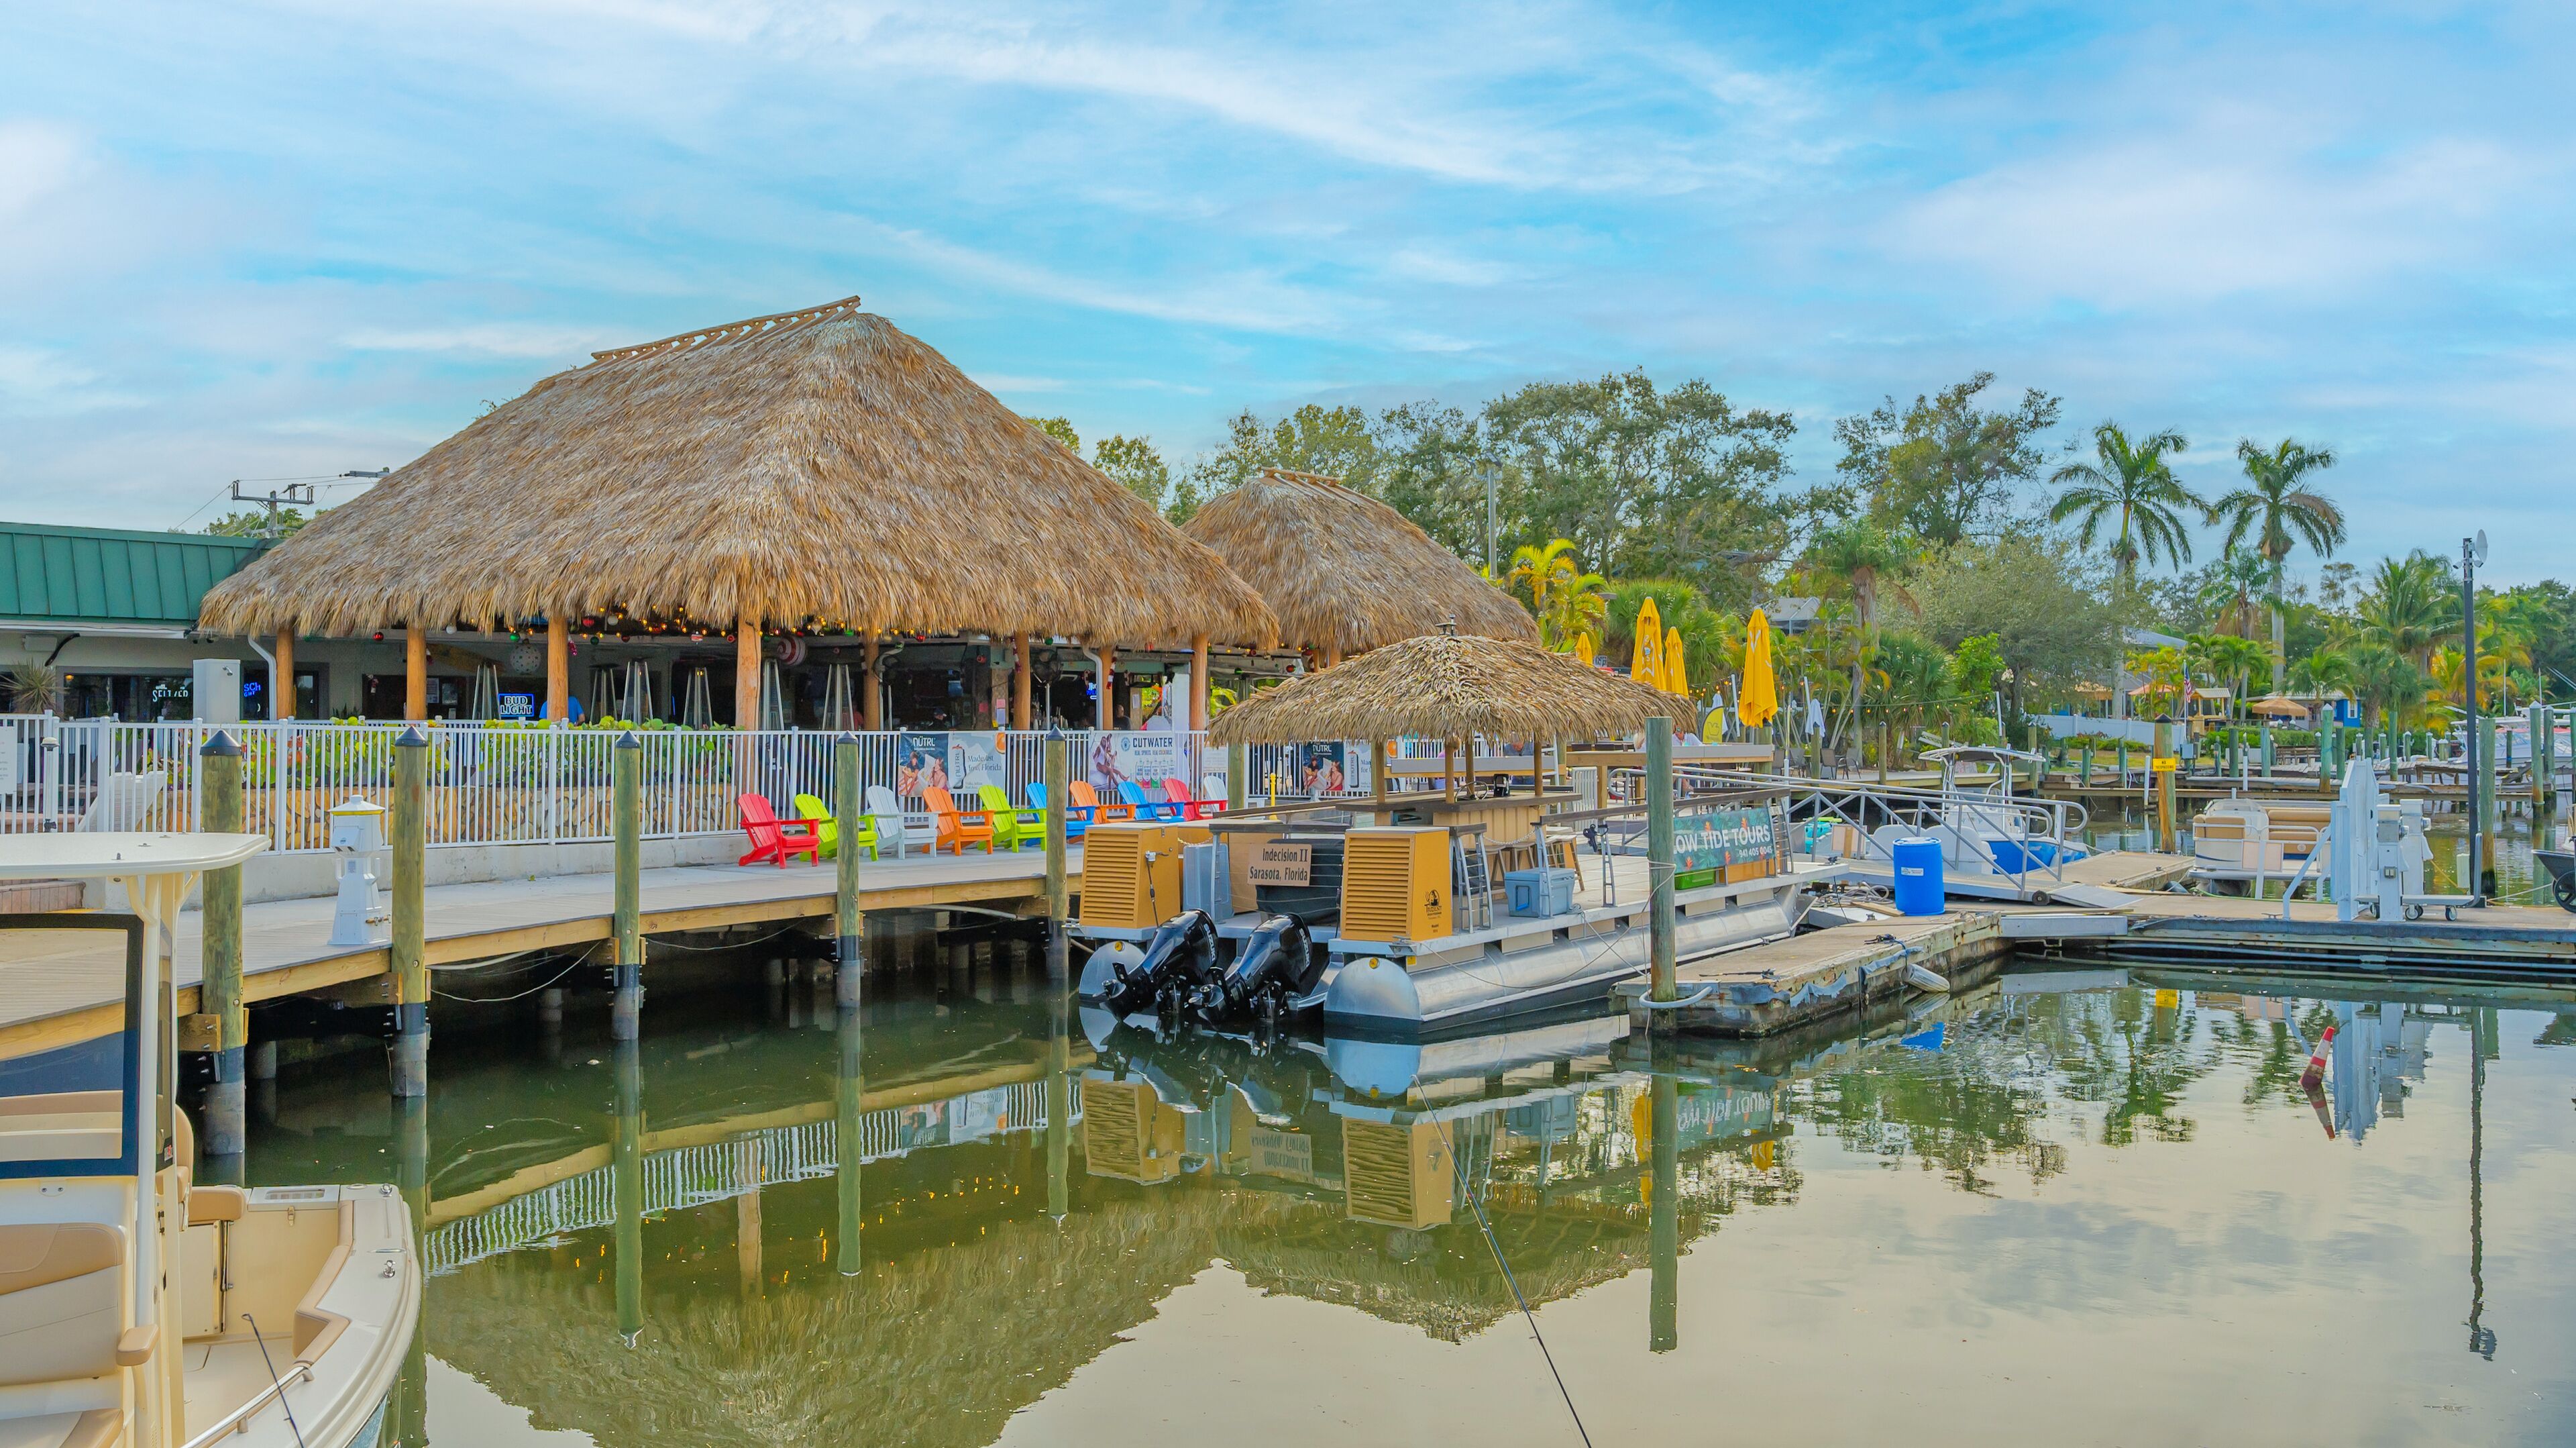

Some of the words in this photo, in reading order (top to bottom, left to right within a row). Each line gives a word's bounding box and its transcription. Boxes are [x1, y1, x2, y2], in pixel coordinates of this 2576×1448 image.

[504, 695, 528, 705] BUD
[500, 705, 532, 715] LIGHT
[1132, 737, 1173, 747] CUTWATER
[1701, 829, 1730, 849] TIDE
[1731, 824, 1771, 845] TOURS
[1263, 848, 1297, 862] Indecision
[1299, 849, 1308, 862] II
[1739, 849, 1748, 858] 941
[1749, 847, 1759, 856] 405
[1760, 845, 1772, 854] 0045
[1250, 866, 1281, 881] Sarasota,
[1285, 867, 1308, 880] Florida
[1203, 923, 1216, 962] SUZUKI
[1299, 927, 1310, 967] SUZUKI
